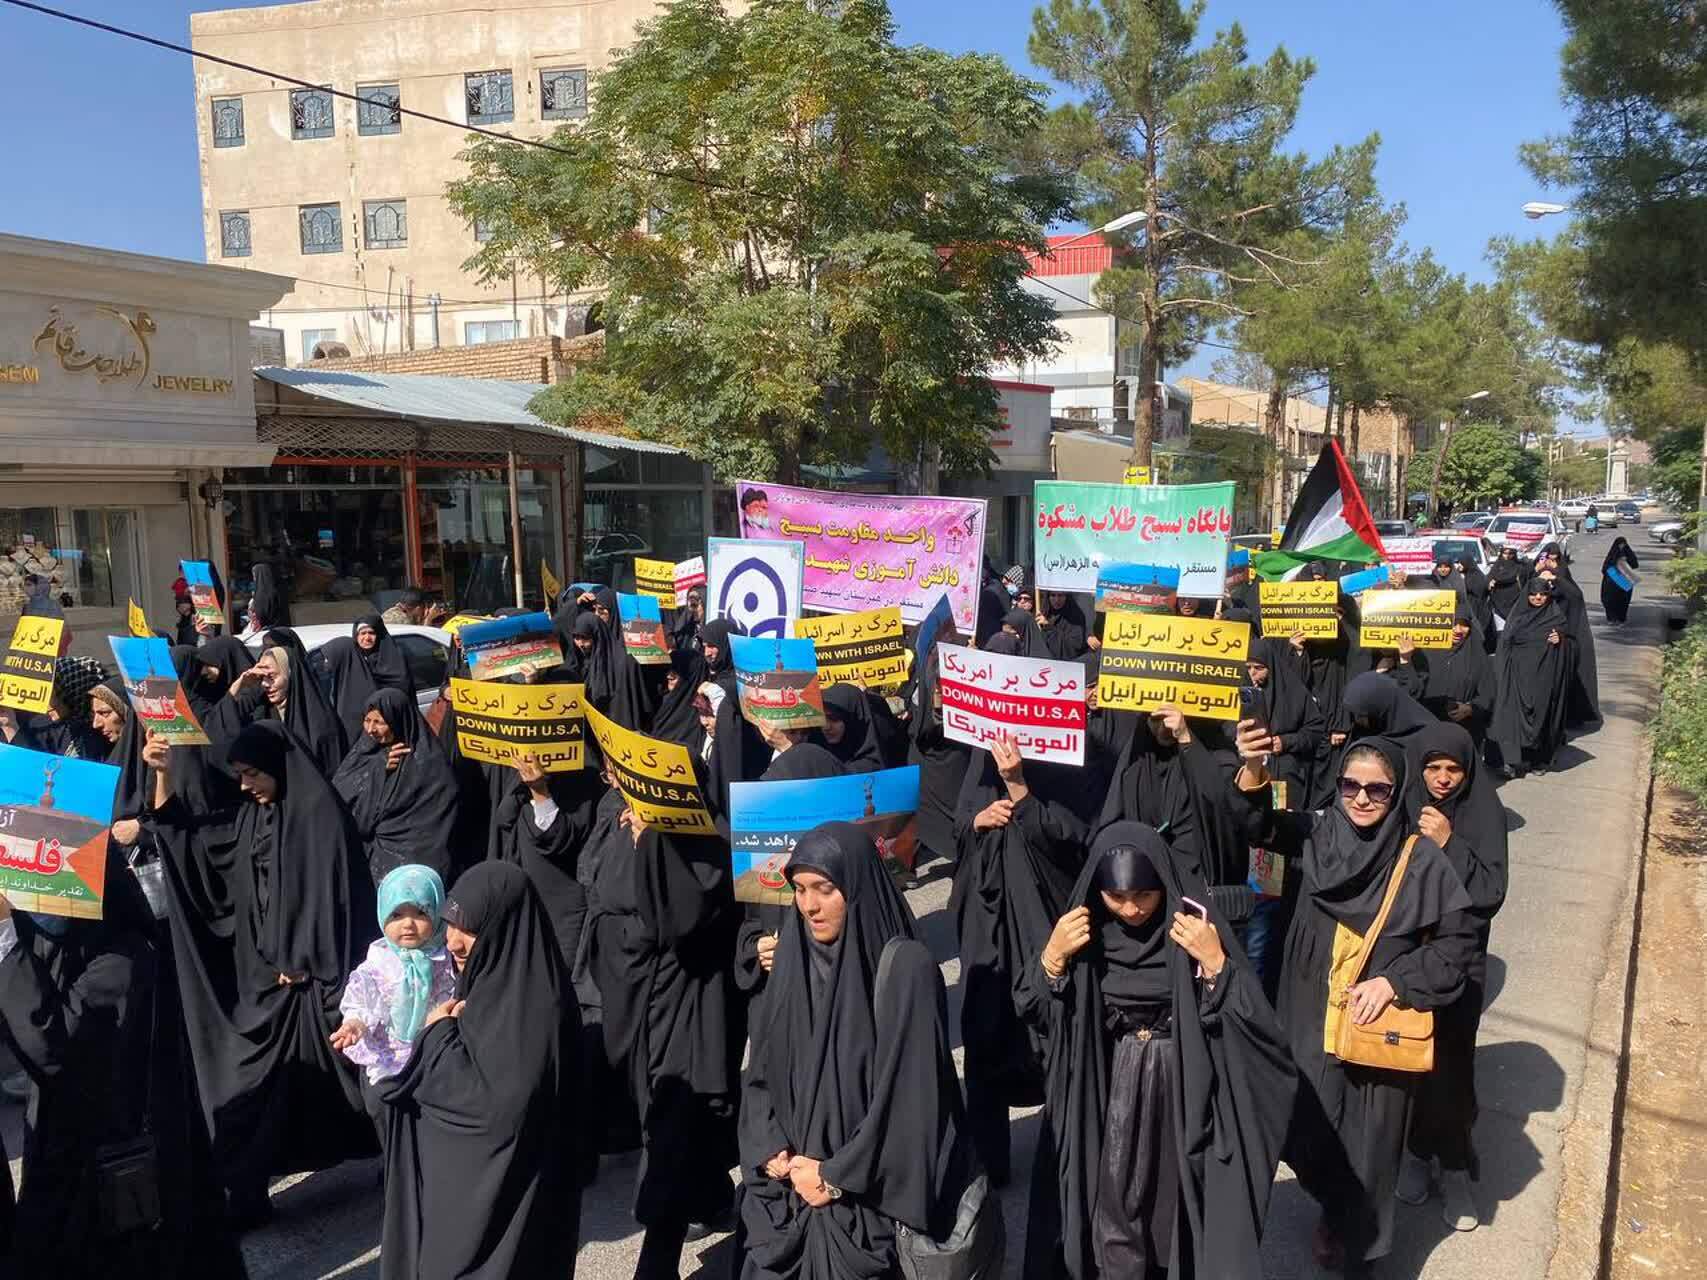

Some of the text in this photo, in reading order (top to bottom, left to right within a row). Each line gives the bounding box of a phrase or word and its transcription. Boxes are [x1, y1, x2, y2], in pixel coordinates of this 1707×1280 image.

[152, 375, 233, 393] JEWELRY
[1090, 504, 1137, 537] طلاب
[1140, 513, 1183, 542] بسیج
[1187, 506, 1233, 543] پایگاه
[779, 516, 936, 552] واحد مقاومت بسیج
[805, 556, 960, 589] دانش آموزی شهید
[1183, 561, 1217, 577] مستقر
[1262, 586, 1335, 602] مرگ بر اسرائیل
[866, 614, 898, 634] مرگ
[1302, 621, 1336, 635] الموت
[1362, 615, 1452, 625] DOWN WITH U.S.A
[30, 625, 56, 650] مرگ
[850, 625, 863, 639] بر
[1109, 622, 1242, 654] مرگ بر اسرائیل
[834, 647, 862, 660] WITH
[864, 640, 902, 655] ISRAEL
[24, 657, 53, 674] U.S.A
[863, 659, 905, 681] الموت
[943, 651, 1078, 695] مرگ بر امریکا
[1102, 656, 1241, 679] DOWN WITH ISRAEL
[7, 682, 48, 705] الموت
[456, 687, 579, 717] مرگ بر امریکا
[942, 685, 1081, 721] DOWN WITH U.S.A
[1182, 690, 1239, 712] الموت
[456, 716, 581, 737] DOWN WITH U.S.A
[1015, 732, 1078, 754] الموت
[523, 745, 578, 768] الموت
[621, 749, 633, 767] بر
[640, 748, 686, 778] مرگ
[649, 784, 700, 803] U.S.A
[640, 809, 706, 829] الموت
[764, 834, 798, 852] واهد
[57, 886, 84, 897] تقدیر
